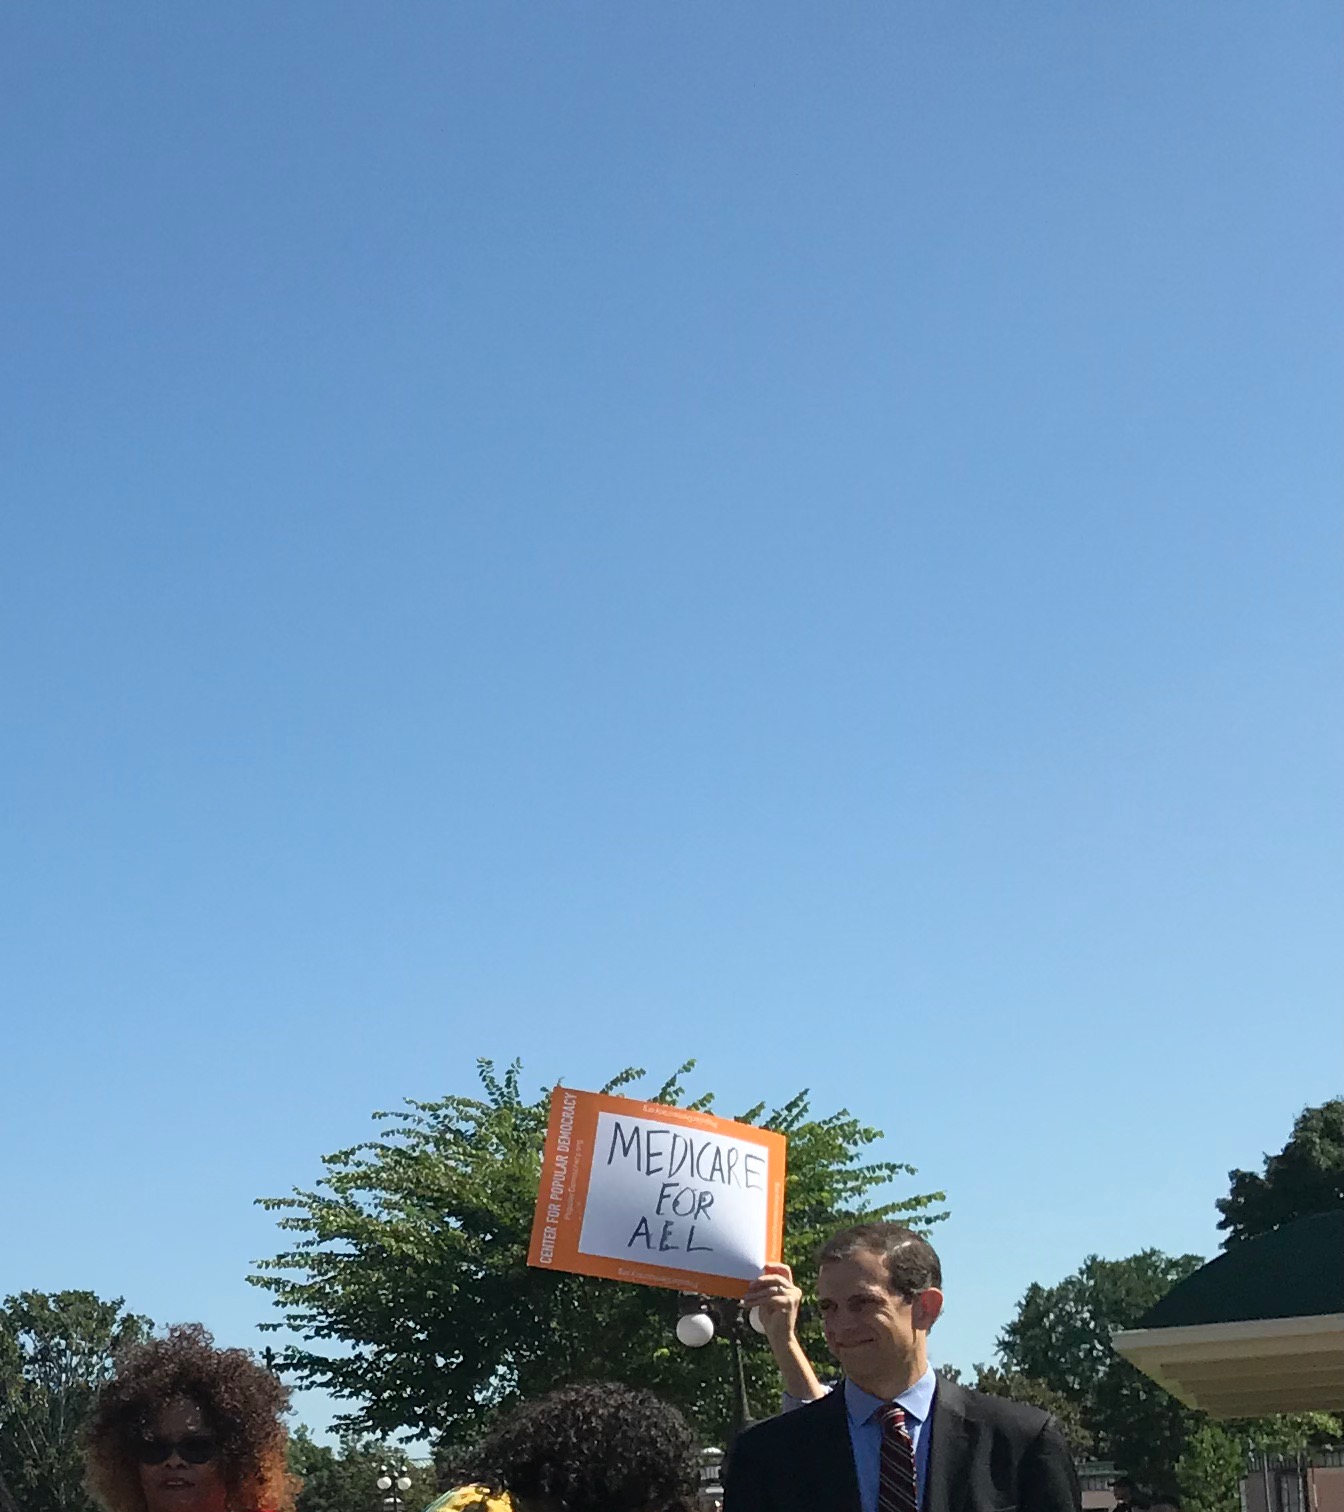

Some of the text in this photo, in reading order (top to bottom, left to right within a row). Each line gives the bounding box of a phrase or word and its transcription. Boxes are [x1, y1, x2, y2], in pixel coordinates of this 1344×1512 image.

[540, 1091, 577, 1265] CENTER FOR POPULAR DEMOCRACY
[607, 1121, 766, 1190] MEDICARE
[655, 1183, 714, 1220] FOR
